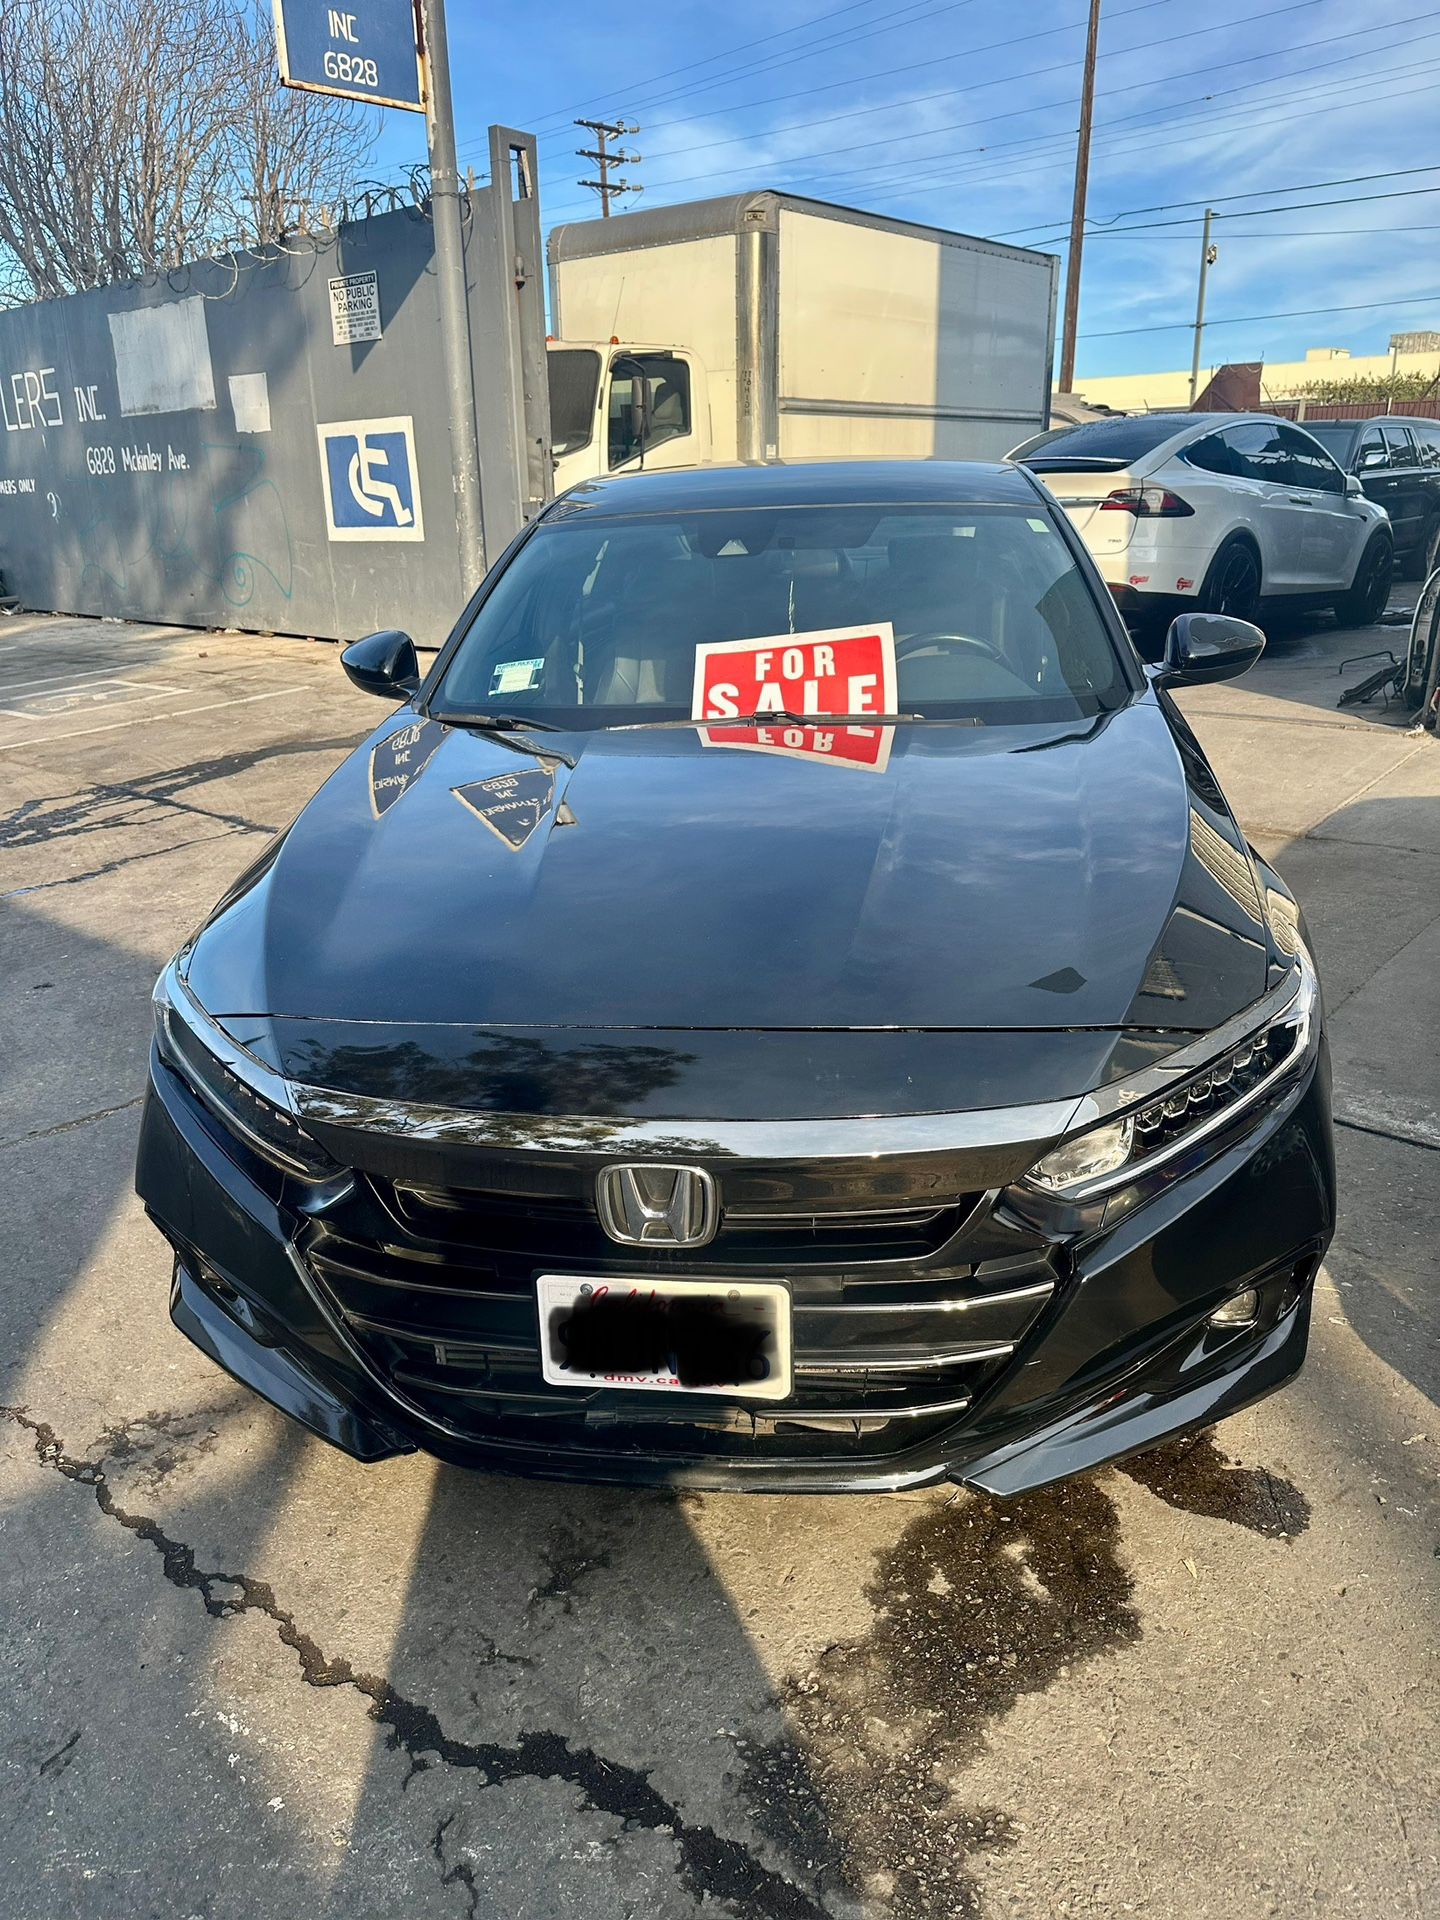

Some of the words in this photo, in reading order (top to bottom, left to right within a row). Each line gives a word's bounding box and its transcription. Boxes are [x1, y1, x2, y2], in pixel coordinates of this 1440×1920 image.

[328, 9, 360, 43] INC
[323, 50, 378, 87] 6828
[333, 291, 345, 302] NO
[346, 285, 375, 299] PUBLIC
[349, 275, 375, 286] PROPERTY
[337, 298, 373, 313] PARKING
[74, 385, 106, 423] INC.
[86, 446, 116, 475] 6828
[167, 444, 190, 471] Ave.
[18, 478, 35, 493] ONLY
[755, 645, 836, 681] FOR
[707, 674, 877, 719] SALE
[603, 1373, 726, 1389] dmv.ca
